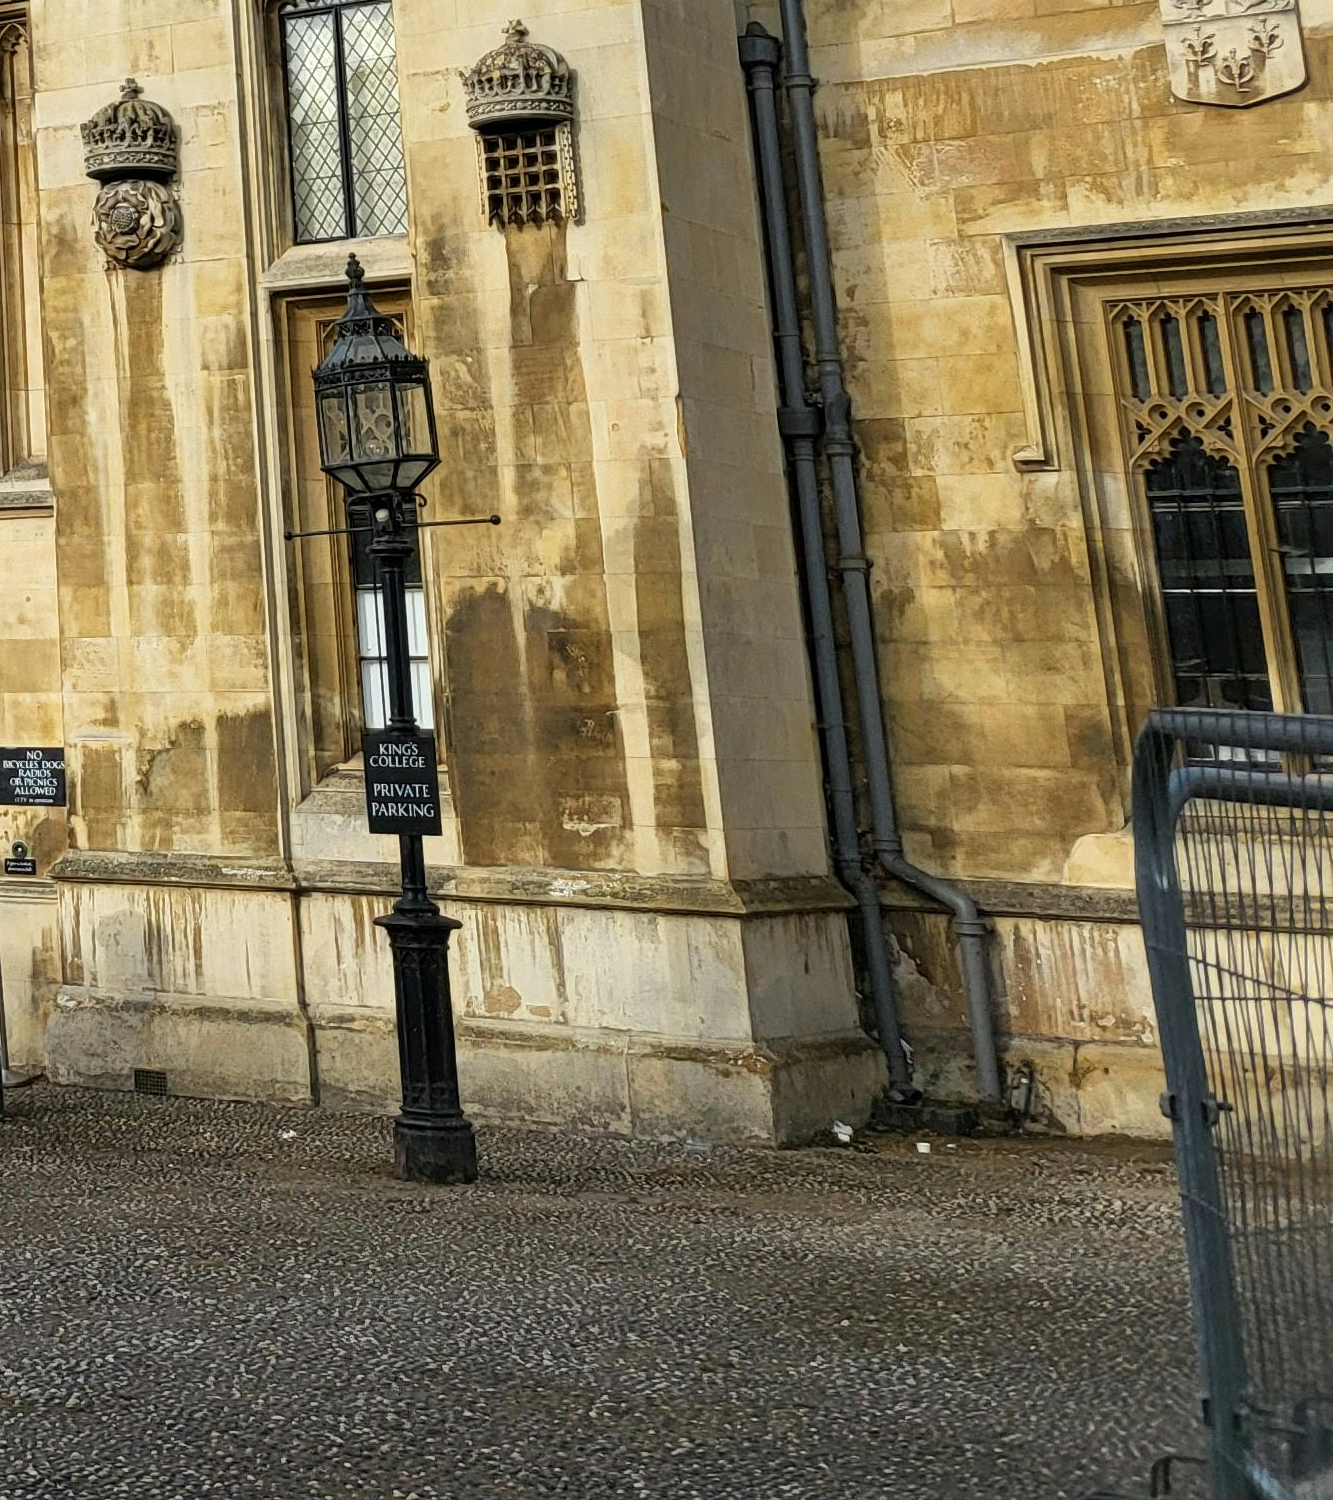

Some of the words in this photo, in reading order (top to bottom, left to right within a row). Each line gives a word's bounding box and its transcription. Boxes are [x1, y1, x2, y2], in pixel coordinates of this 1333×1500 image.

[379, 741, 418, 756] KING'S
[26, 750, 43, 761] NO
[2, 760, 39, 769] BICYCLES
[41, 760, 66, 770] DOGS
[369, 755, 426, 768] COLLEGE
[18, 769, 52, 778] RADIOS
[9, 778, 23, 786] OR
[24, 778, 57, 787] PICNICS
[14, 786, 56, 796] ALLOWED
[373, 783, 431, 798] PRIVATE
[371, 802, 434, 818] PARKING
